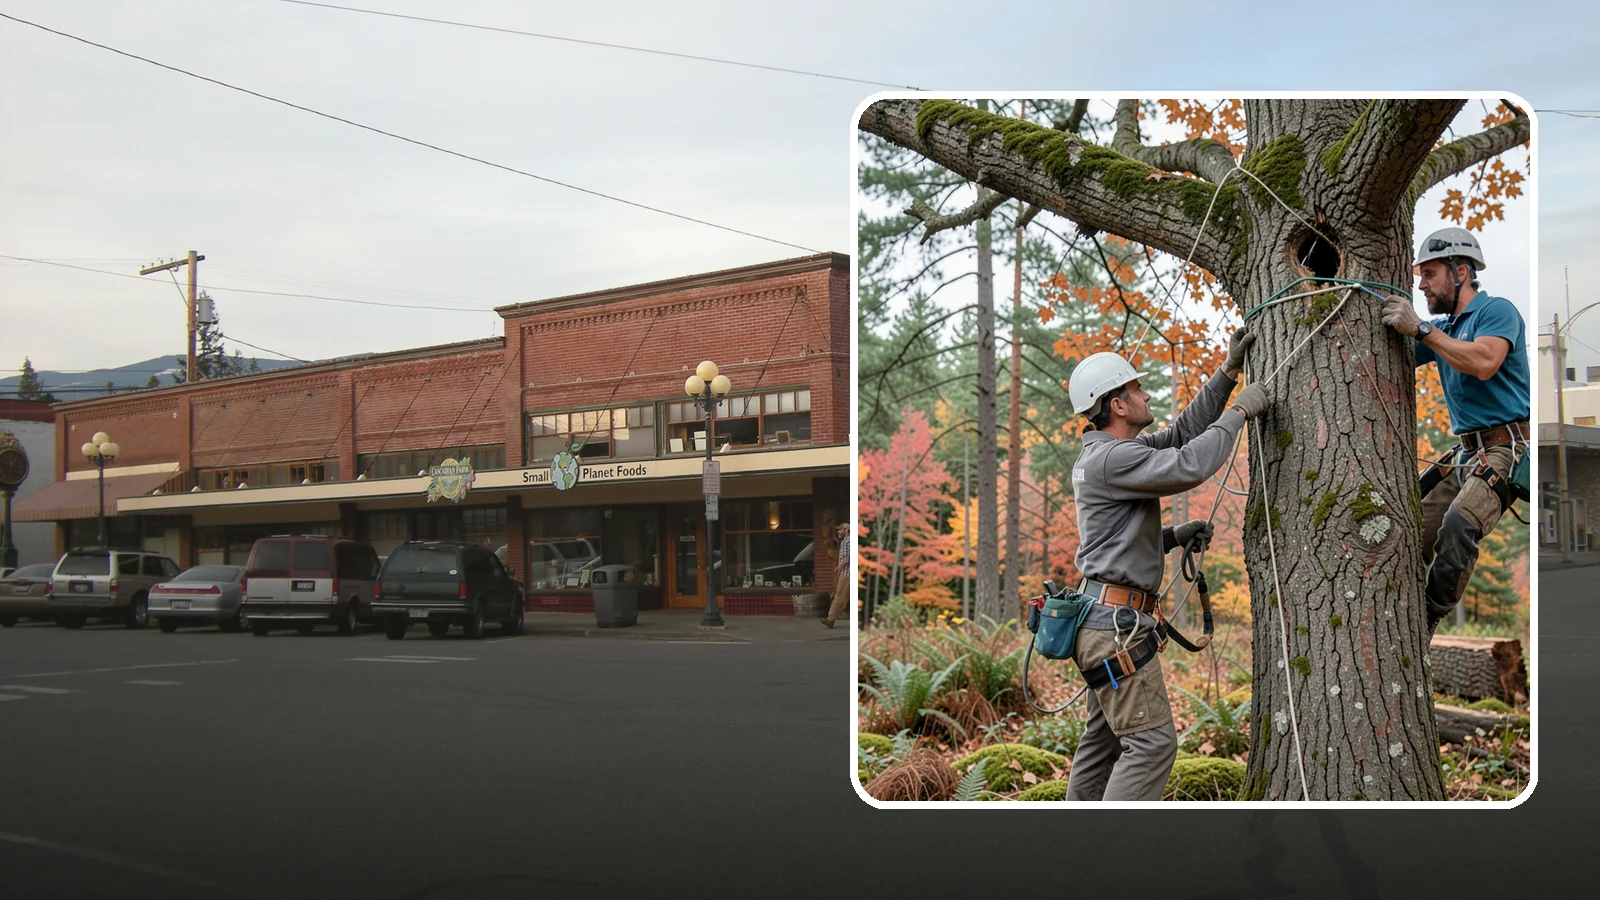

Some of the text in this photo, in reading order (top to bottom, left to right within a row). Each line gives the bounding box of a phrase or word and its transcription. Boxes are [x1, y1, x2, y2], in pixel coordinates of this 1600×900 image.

[523, 464, 647, 483] Small Planet Foods
